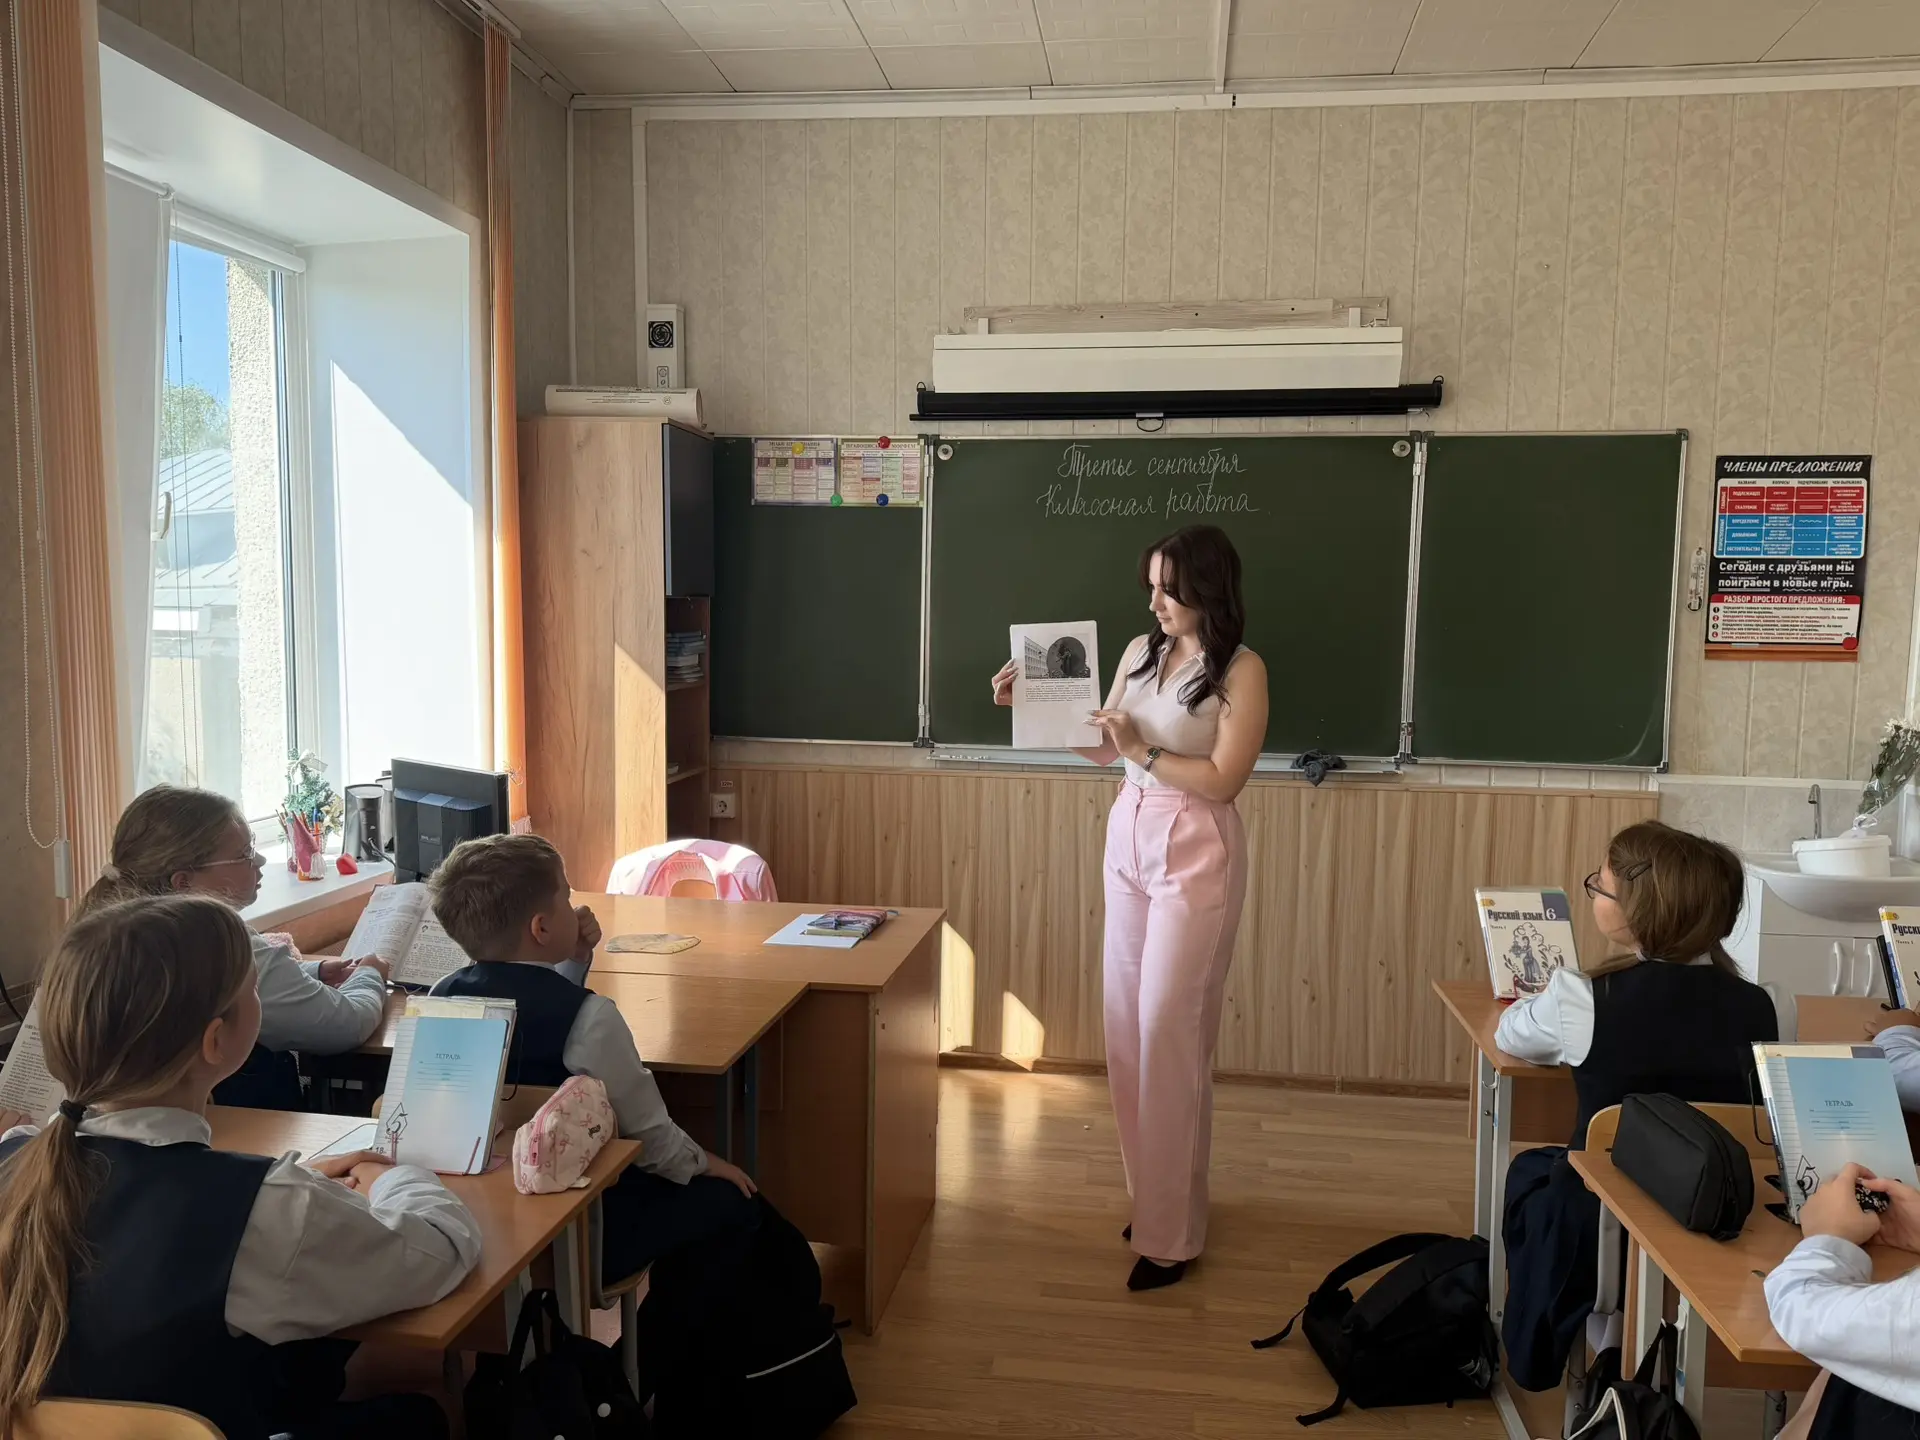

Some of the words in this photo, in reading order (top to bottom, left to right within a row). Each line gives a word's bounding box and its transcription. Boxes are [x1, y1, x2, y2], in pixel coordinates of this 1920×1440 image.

[1147, 447, 1248, 498] сентября
[1724, 460, 1768, 472] ЧЛЕНЫ
[1769, 461, 1863, 473] ПРЕДЛОЖЕНИЯ
[1036, 484, 1157, 518] Классная
[1165, 482, 1259, 520] работа
[1719, 562, 1765, 572] Сегодня
[1777, 563, 1833, 573] друзьями
[1836, 564, 1855, 572] мы
[1718, 579, 1771, 589] поиграем
[1782, 580, 1818, 588] новые
[1821, 580, 1853, 589] игры.
[1488, 910, 1521, 922] Русский
[1522, 912, 1544, 921] язык
[1546, 908, 1557, 920] 6
